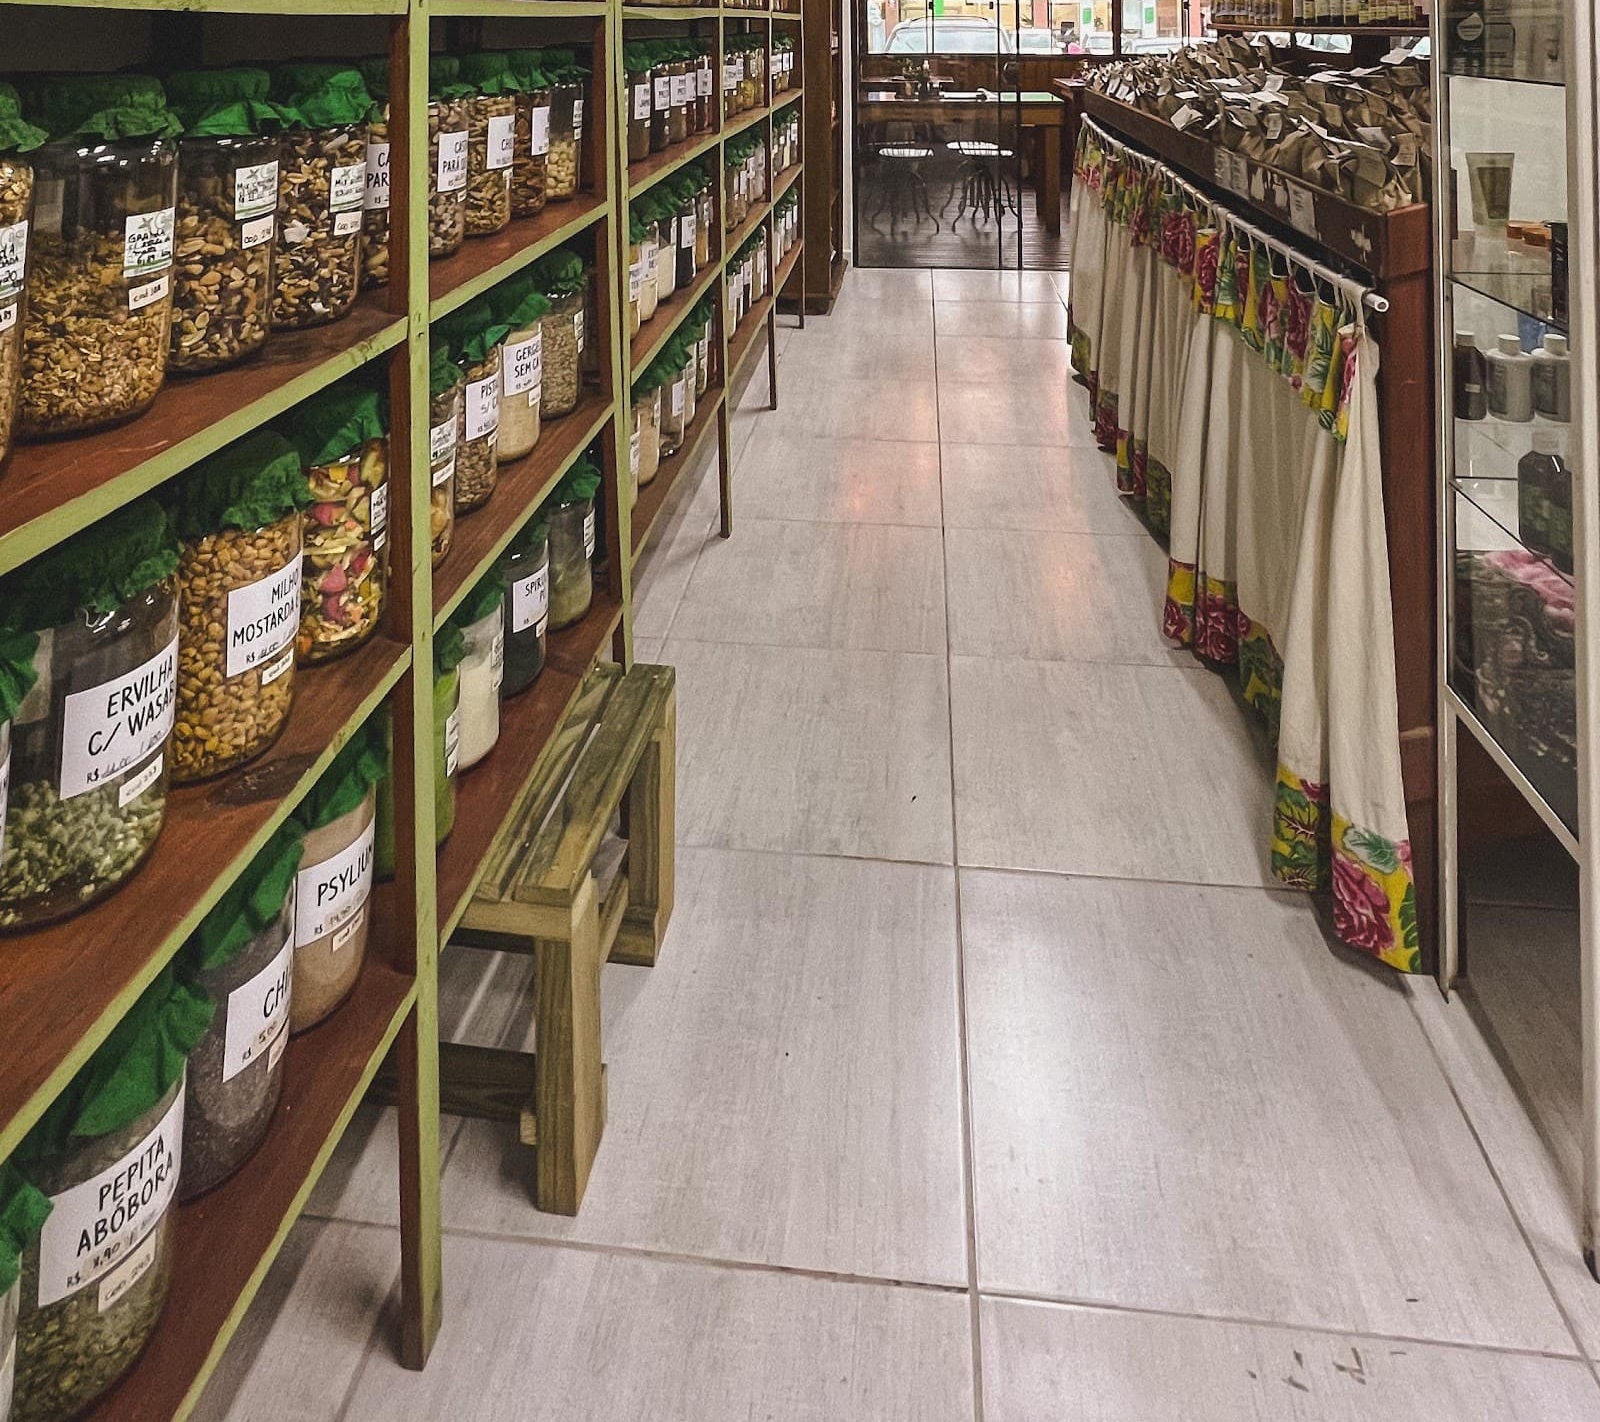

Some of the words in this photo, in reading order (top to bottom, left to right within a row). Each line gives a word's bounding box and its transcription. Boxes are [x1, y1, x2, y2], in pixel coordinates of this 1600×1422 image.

[232, 602, 294, 648] MOSTARDA
[107, 654, 173, 718] ERVILHA
[263, 966, 290, 1019] CHI
[76, 1150, 173, 1258] ABÓBORA
[98, 1134, 165, 1212] PEPITA
